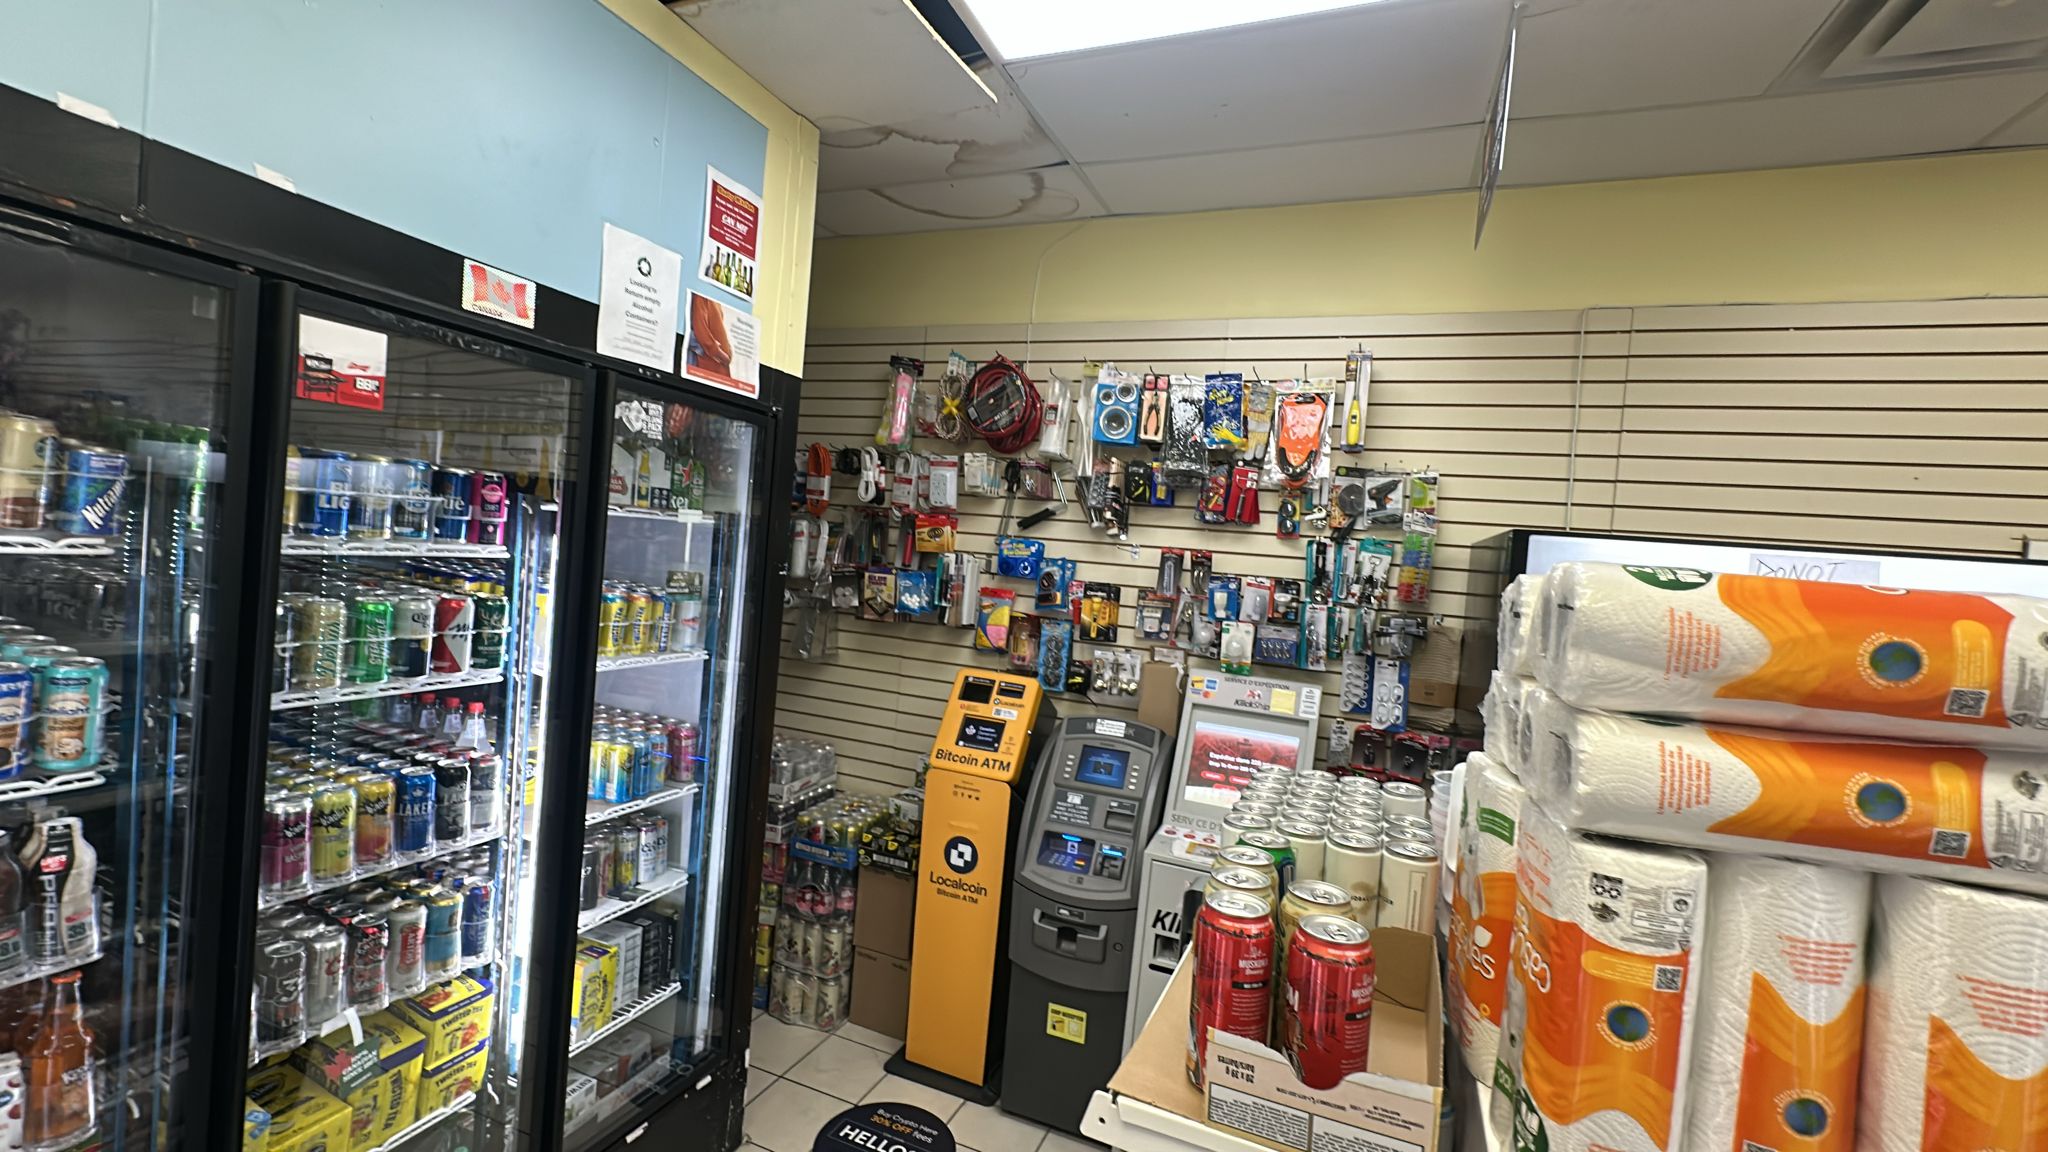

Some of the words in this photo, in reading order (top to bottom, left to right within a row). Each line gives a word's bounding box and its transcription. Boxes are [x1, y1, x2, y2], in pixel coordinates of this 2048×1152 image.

[935, 748, 979, 767] Bitcoin
[980, 757, 1012, 773] ATM
[929, 870, 988, 897] Localcoin
[936, 887, 961, 901] Bitcoin
[960, 894, 979, 905] ATM
[891, 1122, 914, 1135] OFF
[892, 1113, 919, 1129] Crypto
[838, 1123, 917, 1152] HELLO
